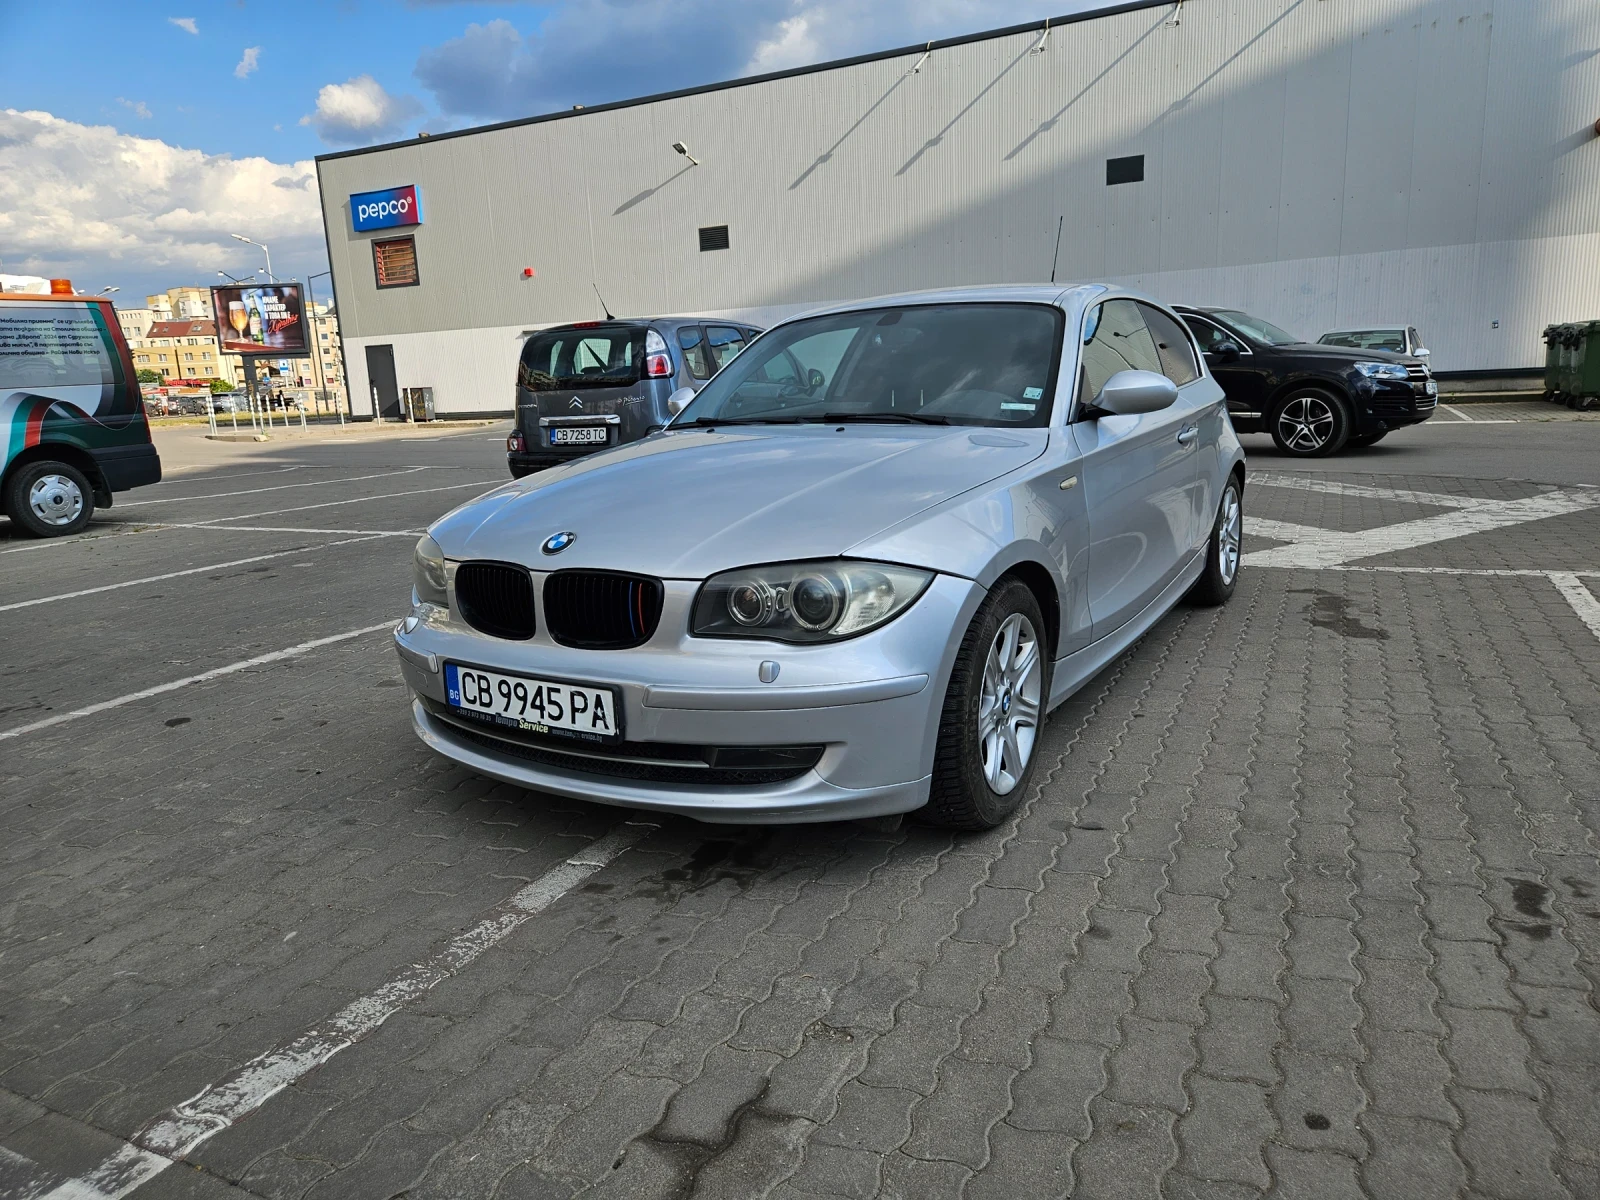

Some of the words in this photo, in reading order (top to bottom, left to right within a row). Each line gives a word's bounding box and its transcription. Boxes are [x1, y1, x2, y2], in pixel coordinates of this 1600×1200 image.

[358, 199, 408, 222] pepco
[556, 430, 568, 441] CB
[569, 429, 591, 441] 7258
[593, 429, 605, 440] TC
[450, 689, 460, 700] BG
[462, 672, 493, 708] CB
[497, 679, 563, 721] 9945
[570, 690, 610, 730] PA
[495, 714, 518, 728] Tempo
[519, 718, 549, 733] Service
